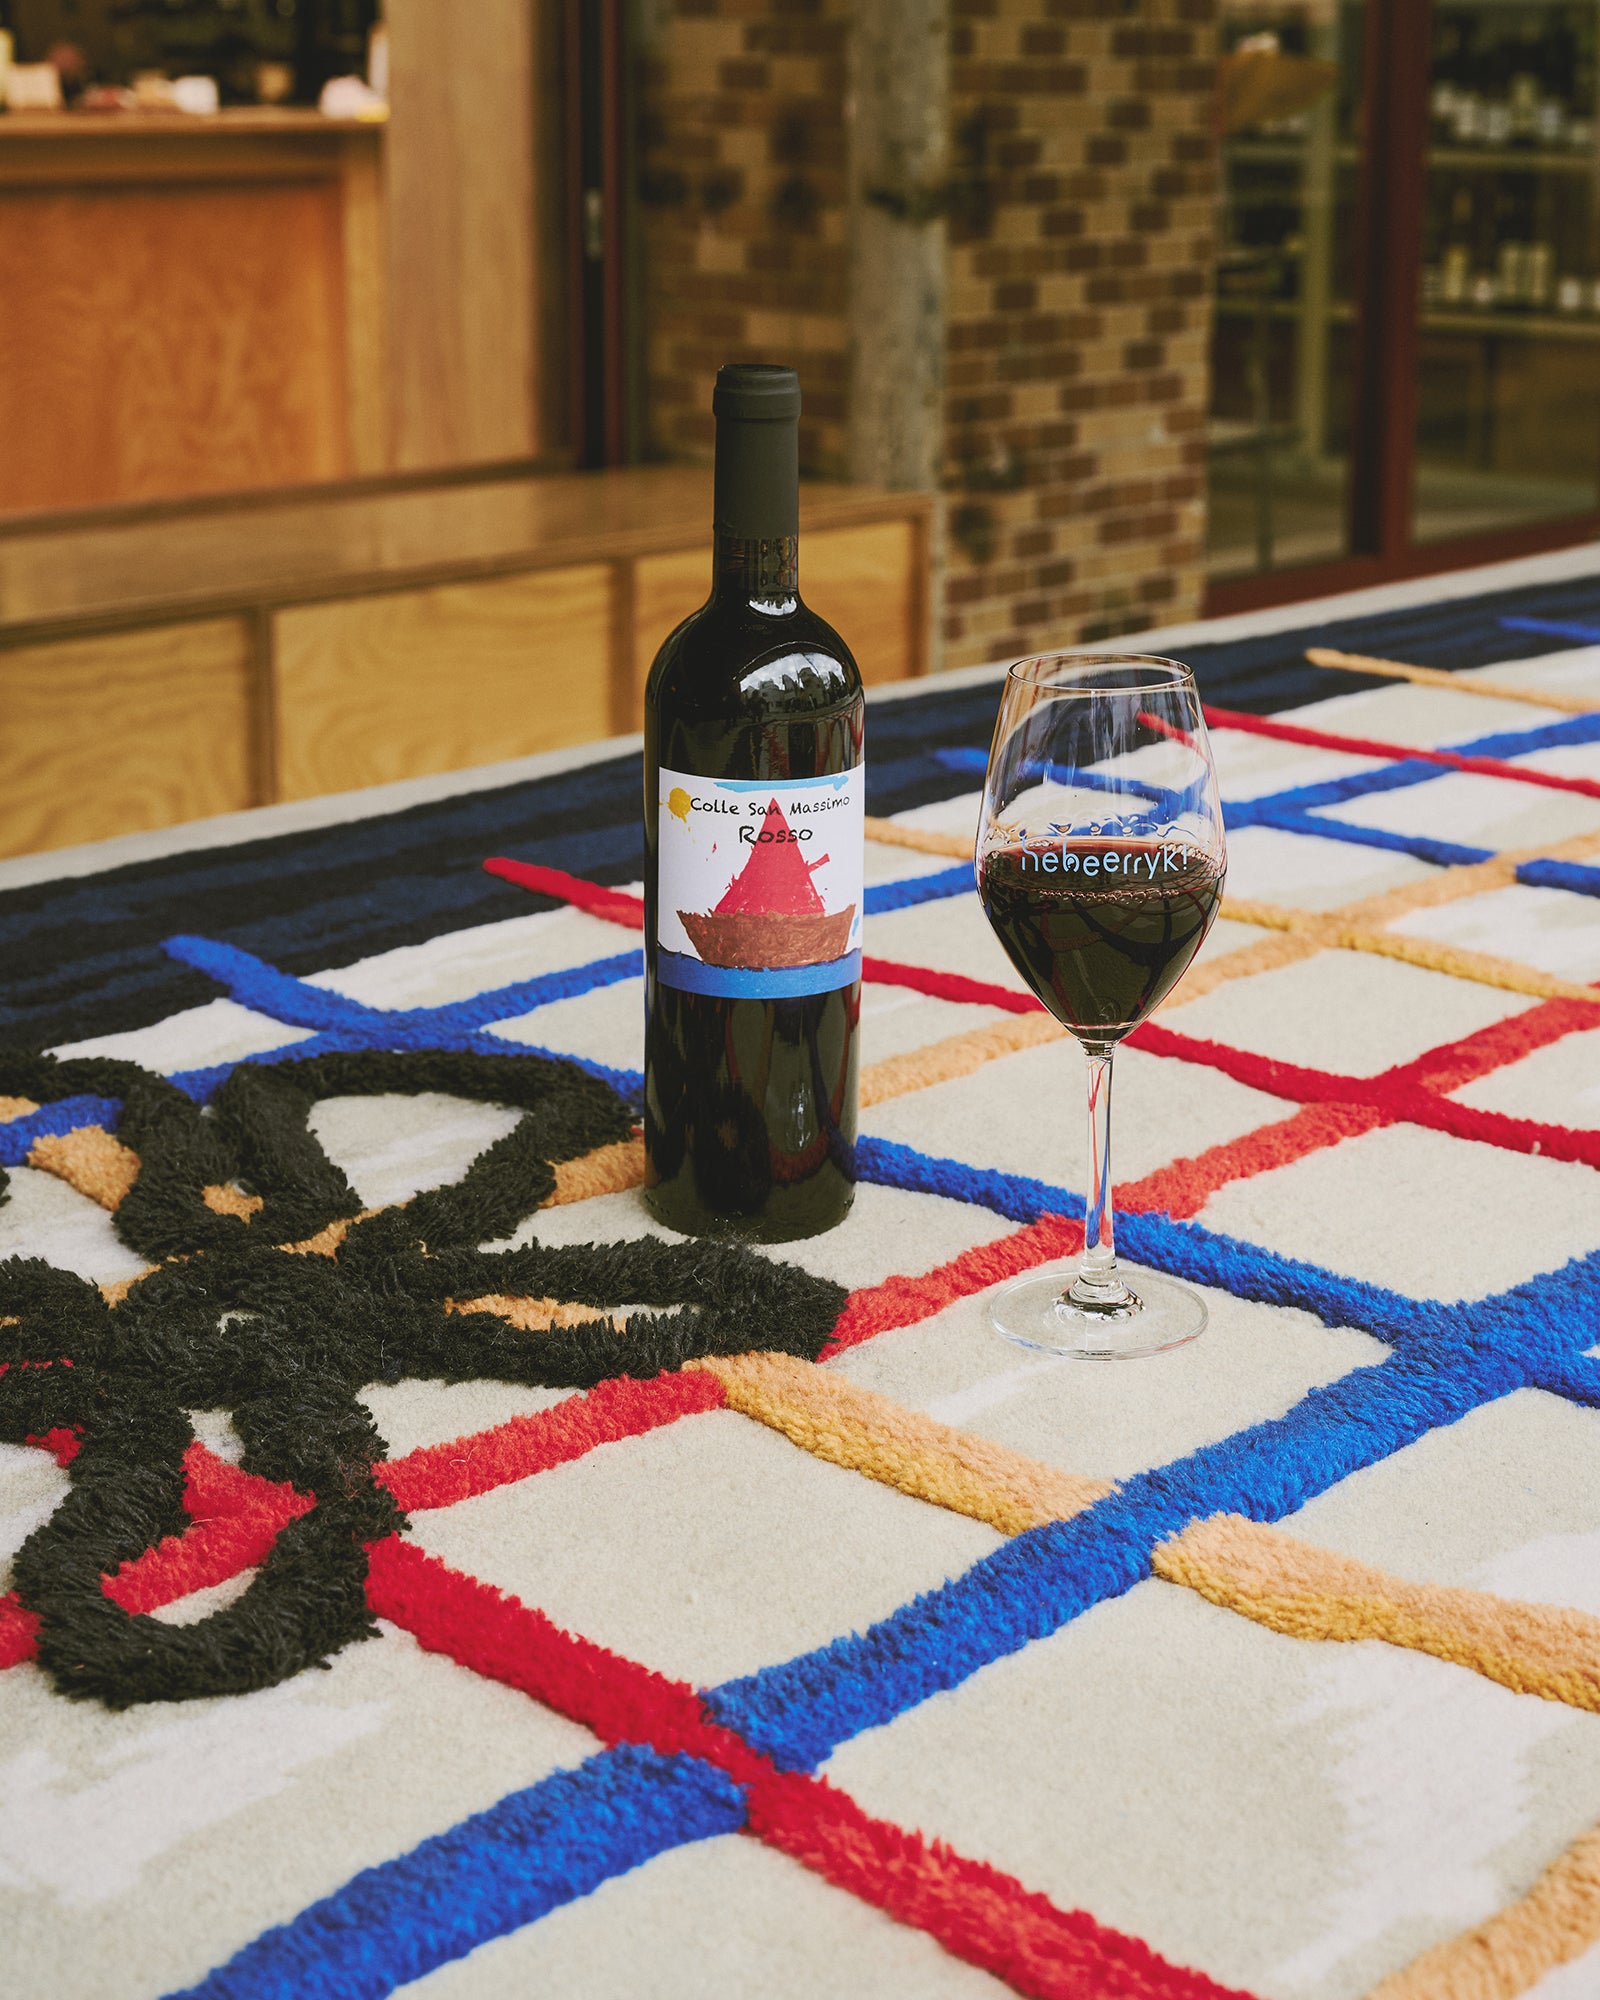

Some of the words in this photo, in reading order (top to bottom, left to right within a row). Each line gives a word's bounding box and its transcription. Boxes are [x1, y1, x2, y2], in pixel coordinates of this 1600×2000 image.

[690, 797, 740, 815] Colle
[749, 802, 781, 816] San
[789, 796, 850, 815] Massimo
[739, 825, 813, 845] Rosso
